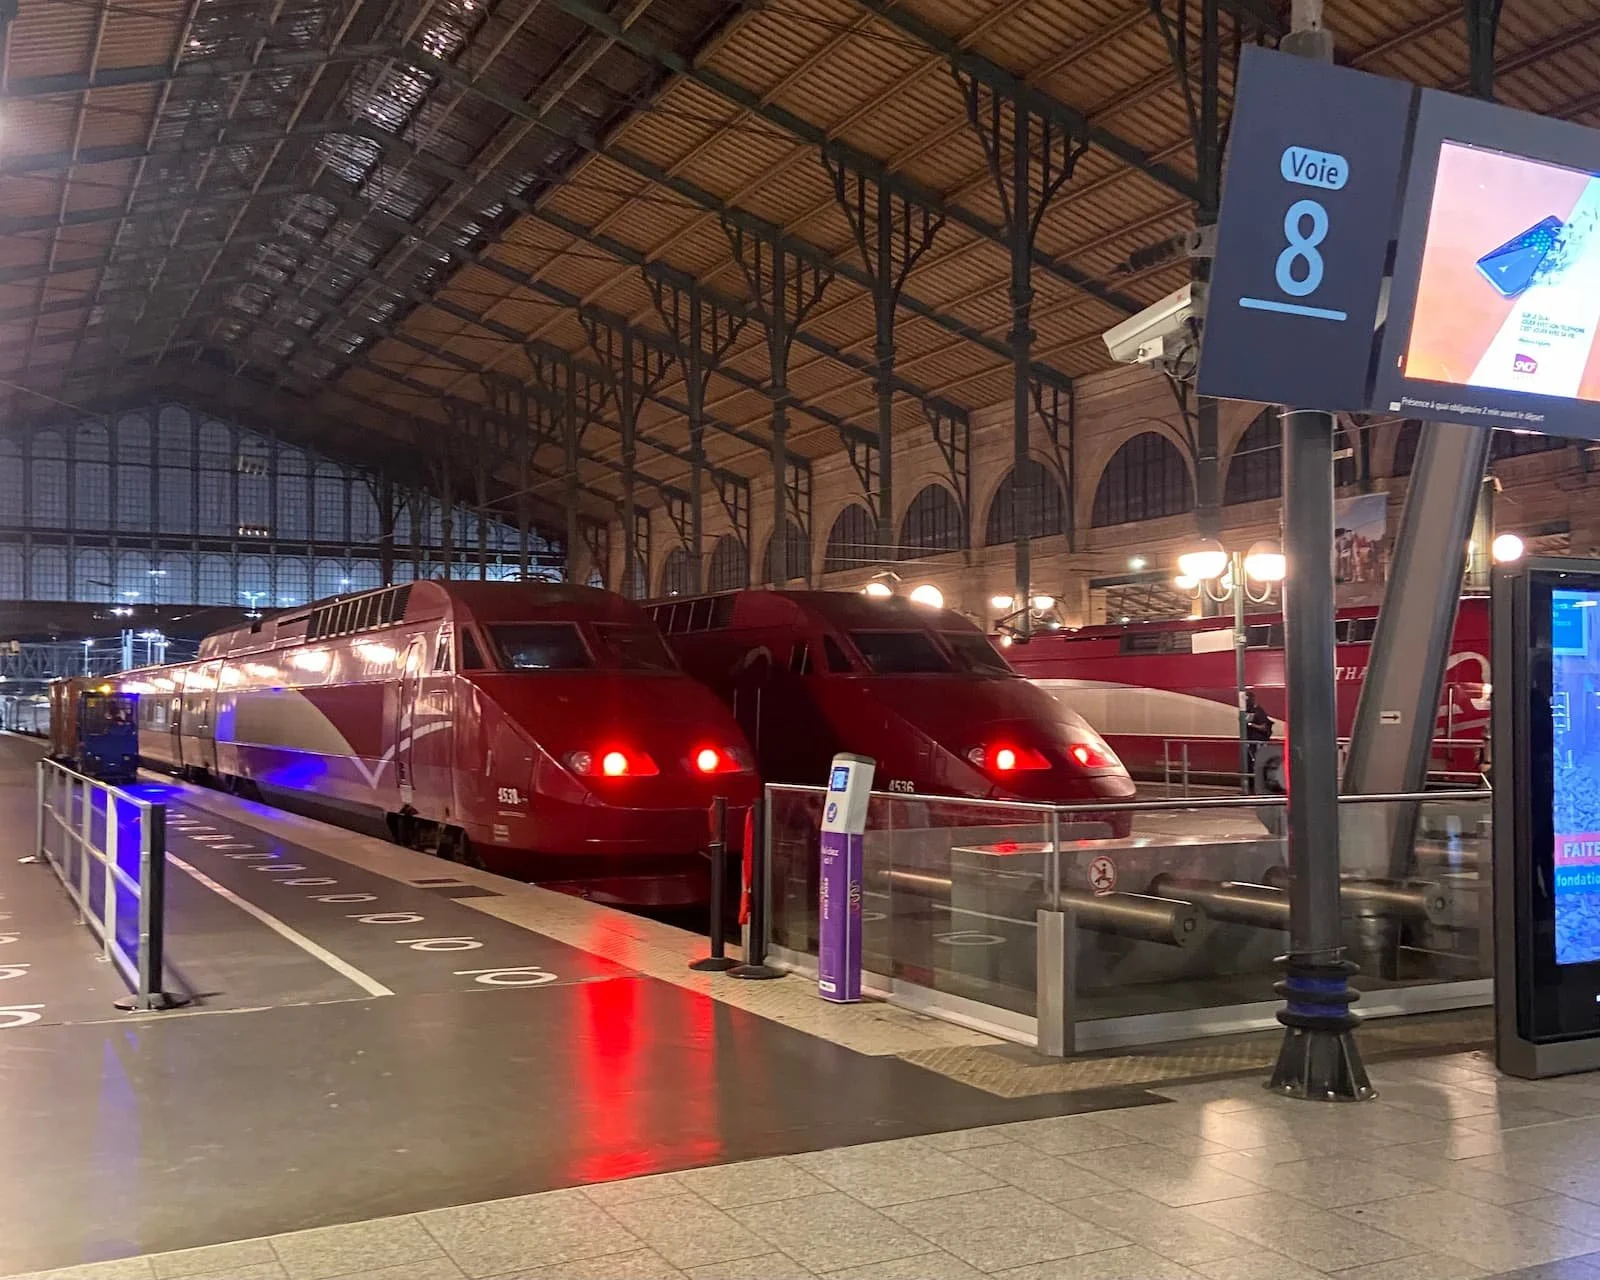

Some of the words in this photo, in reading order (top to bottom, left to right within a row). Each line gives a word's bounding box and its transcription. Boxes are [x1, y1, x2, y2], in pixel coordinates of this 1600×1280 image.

[1291, 151, 1339, 185] Voie
[1275, 199, 1329, 296] 8
[1401, 396, 1430, 409] Présence
[888, 779, 915, 793] 4536
